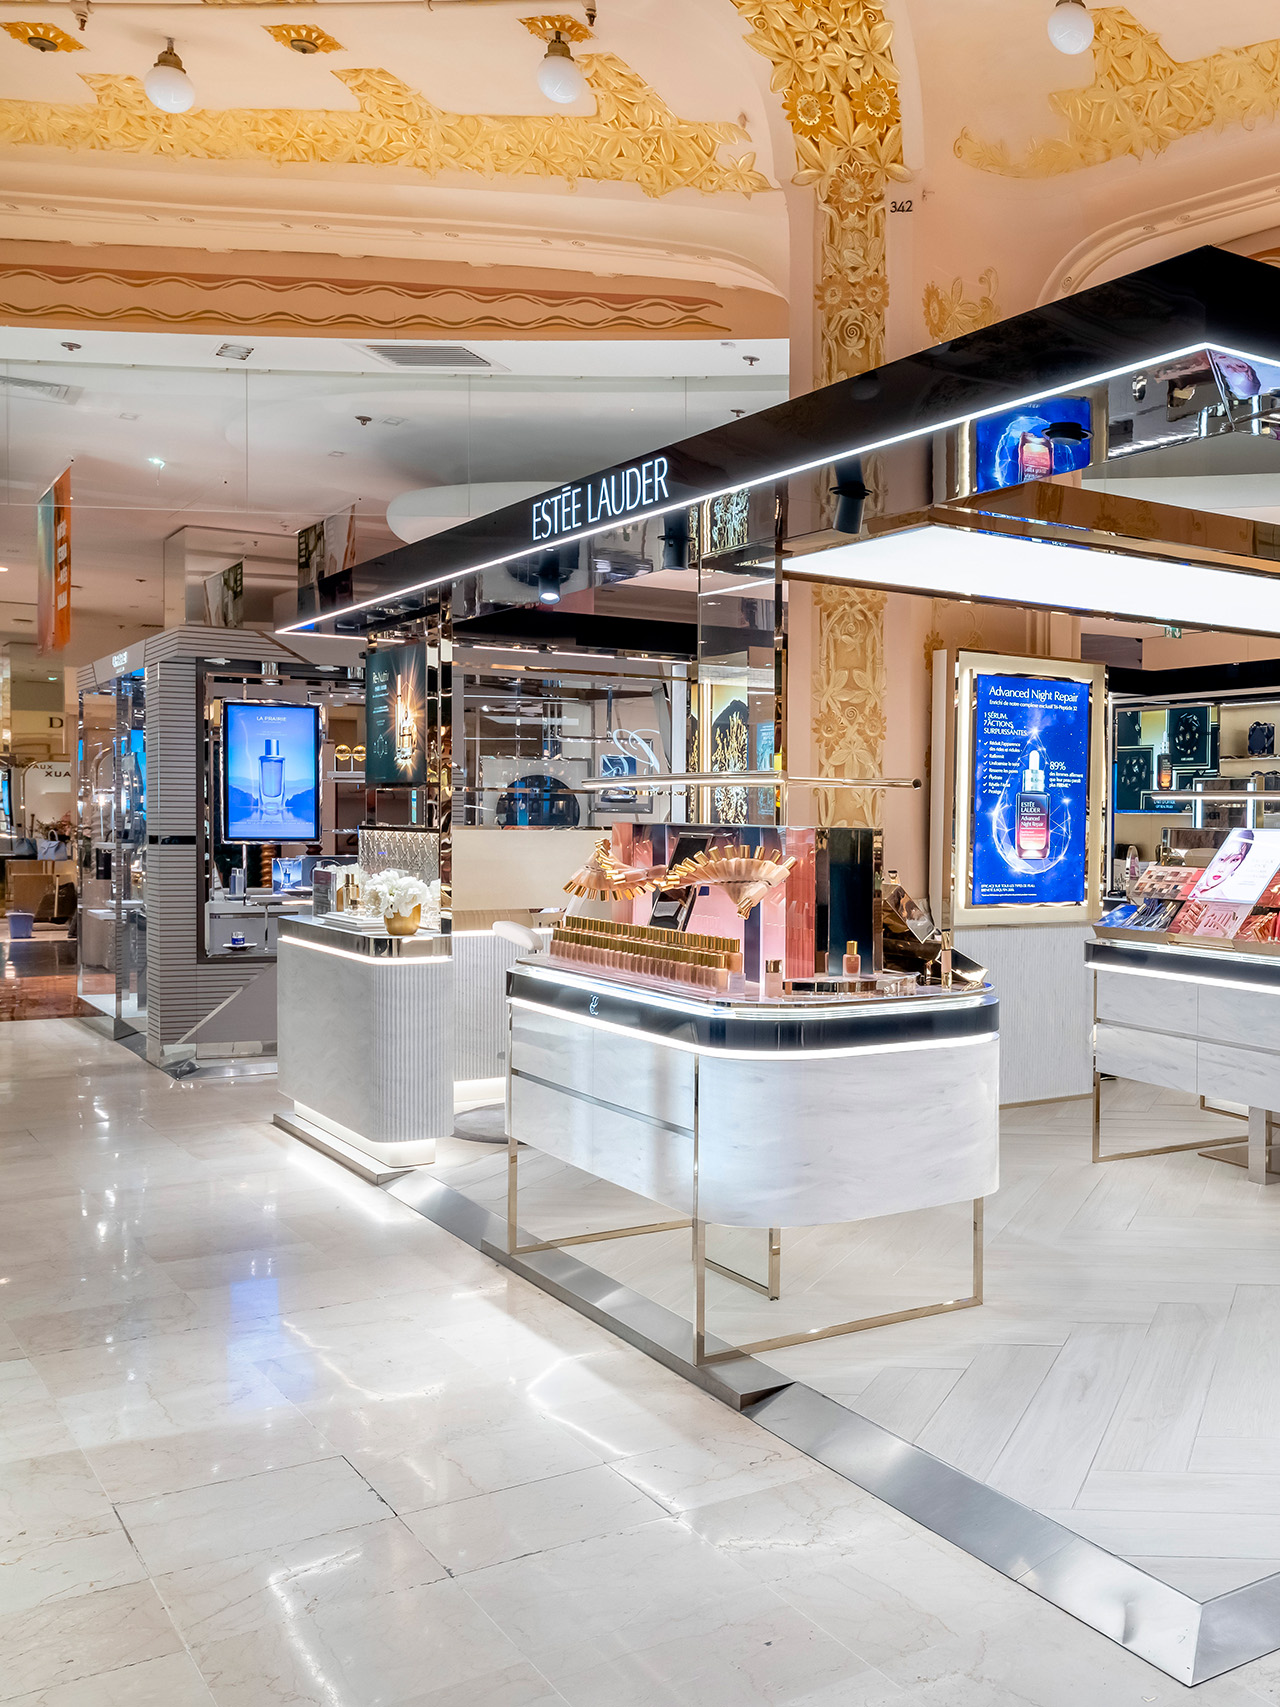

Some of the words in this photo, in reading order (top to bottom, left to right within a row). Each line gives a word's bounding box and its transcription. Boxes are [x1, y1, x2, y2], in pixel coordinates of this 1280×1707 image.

[890, 200, 913, 213] 342
[587, 456, 669, 523] LAUDER
[989, 686, 1030, 698] Advanced
[1031, 689, 1053, 703] Night
[1054, 691, 1078, 703] Repair
[1049, 761, 1067, 771] 89%
